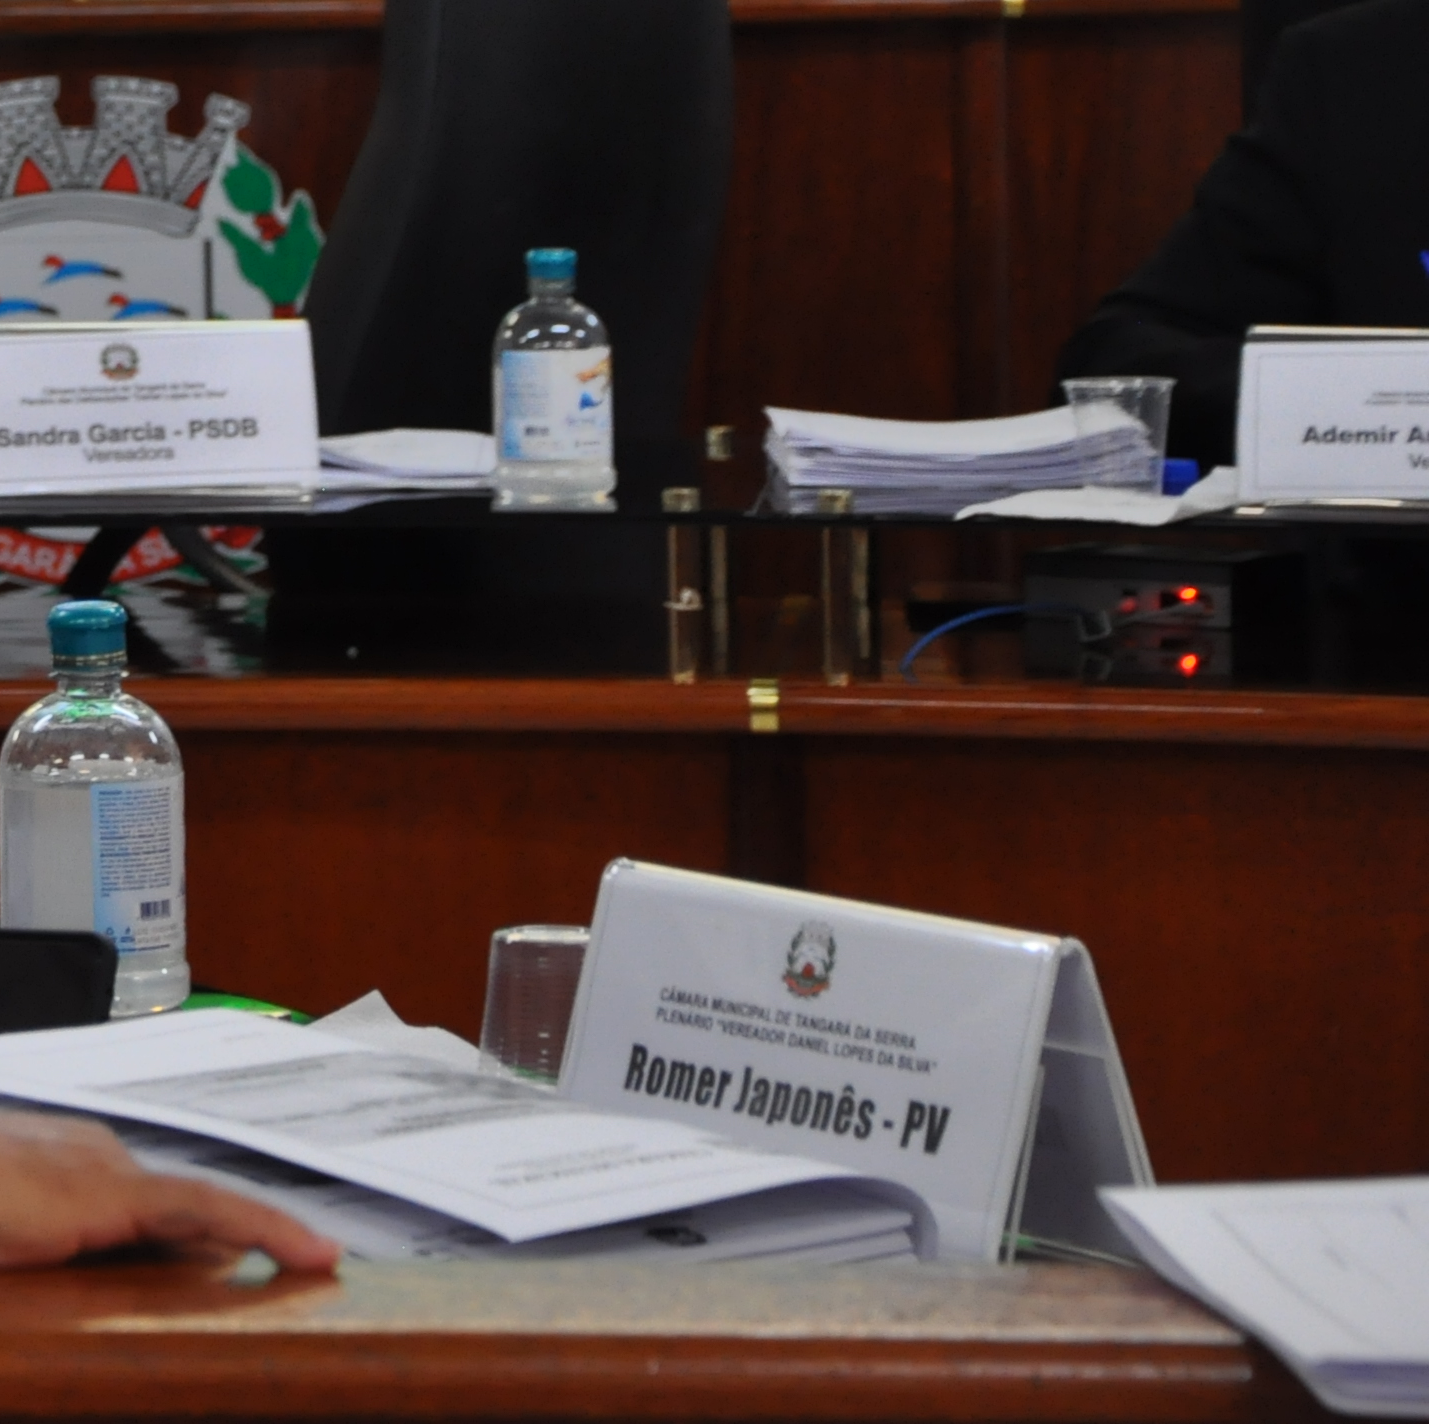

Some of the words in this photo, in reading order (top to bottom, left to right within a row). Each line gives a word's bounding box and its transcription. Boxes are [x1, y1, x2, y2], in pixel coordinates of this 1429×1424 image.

[88, 422, 166, 444] Garcia
[188, 418, 259, 440] PSDB
[1302, 424, 1400, 444] Ademir
[83, 446, 175, 464] Vereadora
[711, 998, 773, 1022] MUNICIPAL
[775, 1009, 791, 1025] DE
[795, 1012, 851, 1037] TANGARÁ
[854, 1025, 872, 1041] DA
[874, 1029, 917, 1051] SERRA
[787, 1034, 831, 1055] DANIEL
[833, 1044, 874, 1063] LOPES
[876, 1051, 895, 1068] DA
[624, 1043, 732, 1110] Romer
[732, 1065, 877, 1140] Japonês
[900, 1099, 952, 1155] PV
